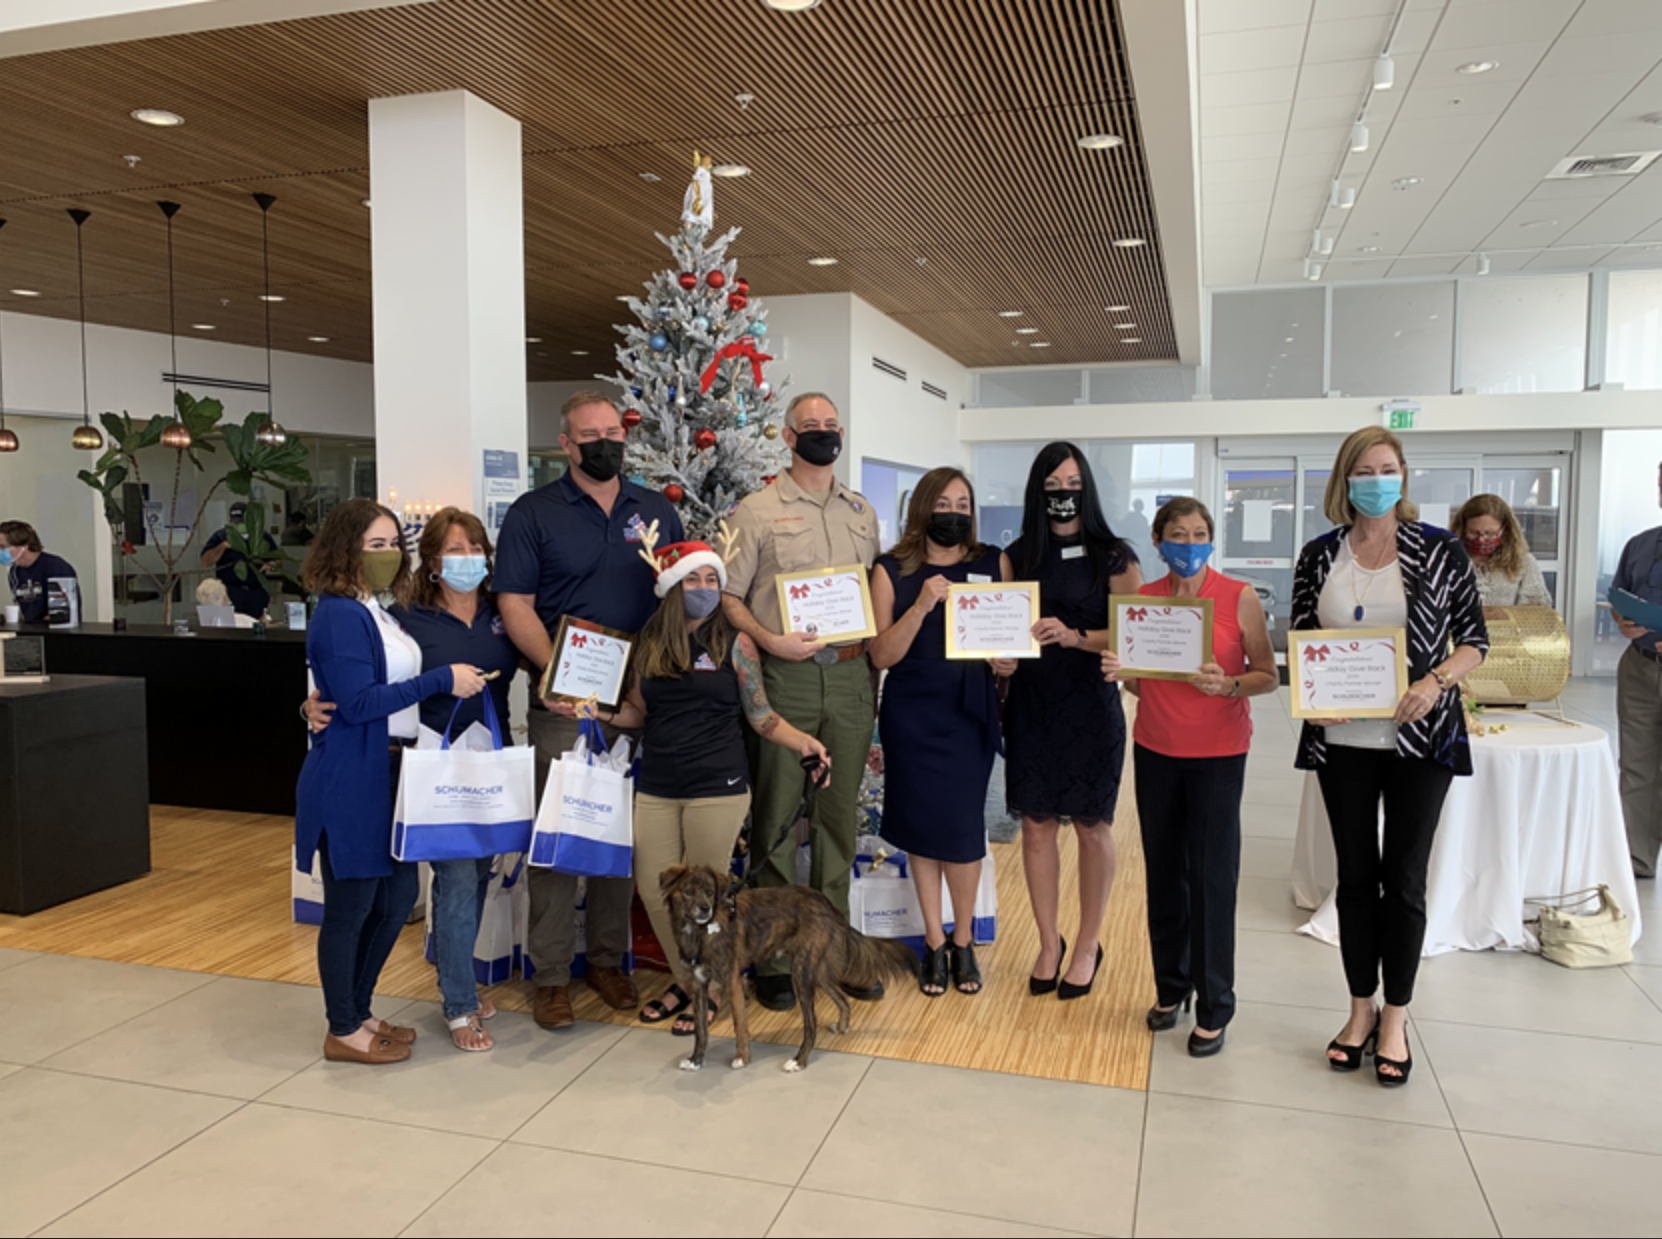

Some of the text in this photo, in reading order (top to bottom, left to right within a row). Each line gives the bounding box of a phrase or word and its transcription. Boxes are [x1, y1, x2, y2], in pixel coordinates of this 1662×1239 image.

[1390, 411, 1415, 429] EXIT
[1367, 664, 1386, 672] Back
[435, 785, 503, 795] SCHUMACHER
